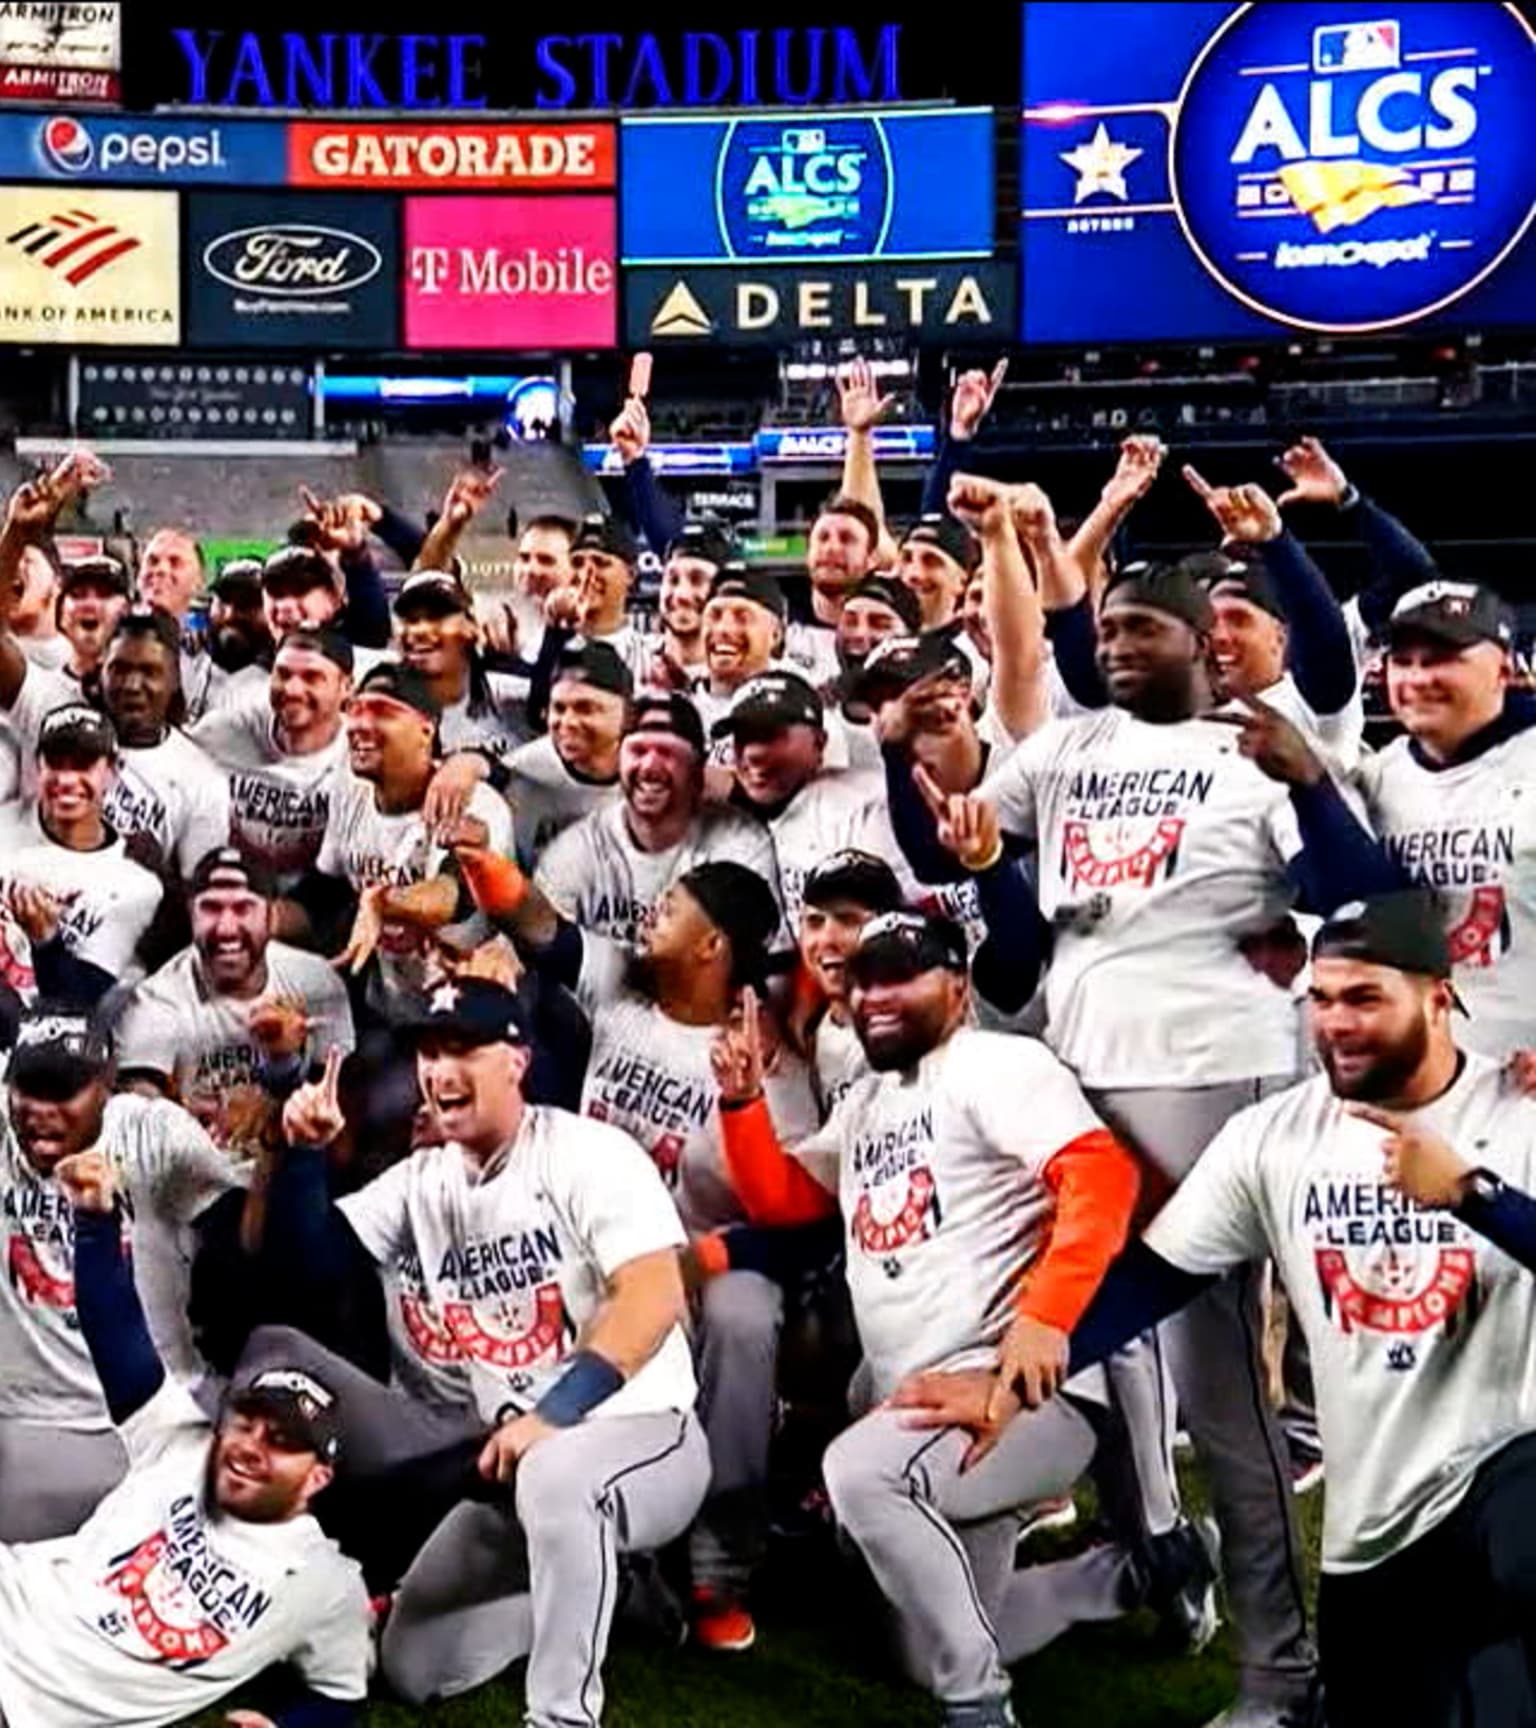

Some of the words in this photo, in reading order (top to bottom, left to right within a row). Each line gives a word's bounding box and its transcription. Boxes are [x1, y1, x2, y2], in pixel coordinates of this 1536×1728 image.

[4, 68, 110, 88] ARMITRON
[172, 29, 486, 109] YANKEE
[534, 23, 903, 108] STADIUM
[1230, 67, 1478, 163] ALCS
[100, 130, 222, 170] pepsi
[311, 134, 595, 177] GATORADE
[744, 153, 864, 195] ALCS
[234, 233, 349, 284] Ford
[412, 249, 447, 294] T
[460, 246, 613, 295] Mobile
[45, 306, 66, 322] OF
[75, 305, 174, 324] AMERICA
[736, 277, 992, 330] DELTA
[1067, 769, 1213, 805] AMERICAN
[1326, 1218, 1457, 1245] LEAGUE
